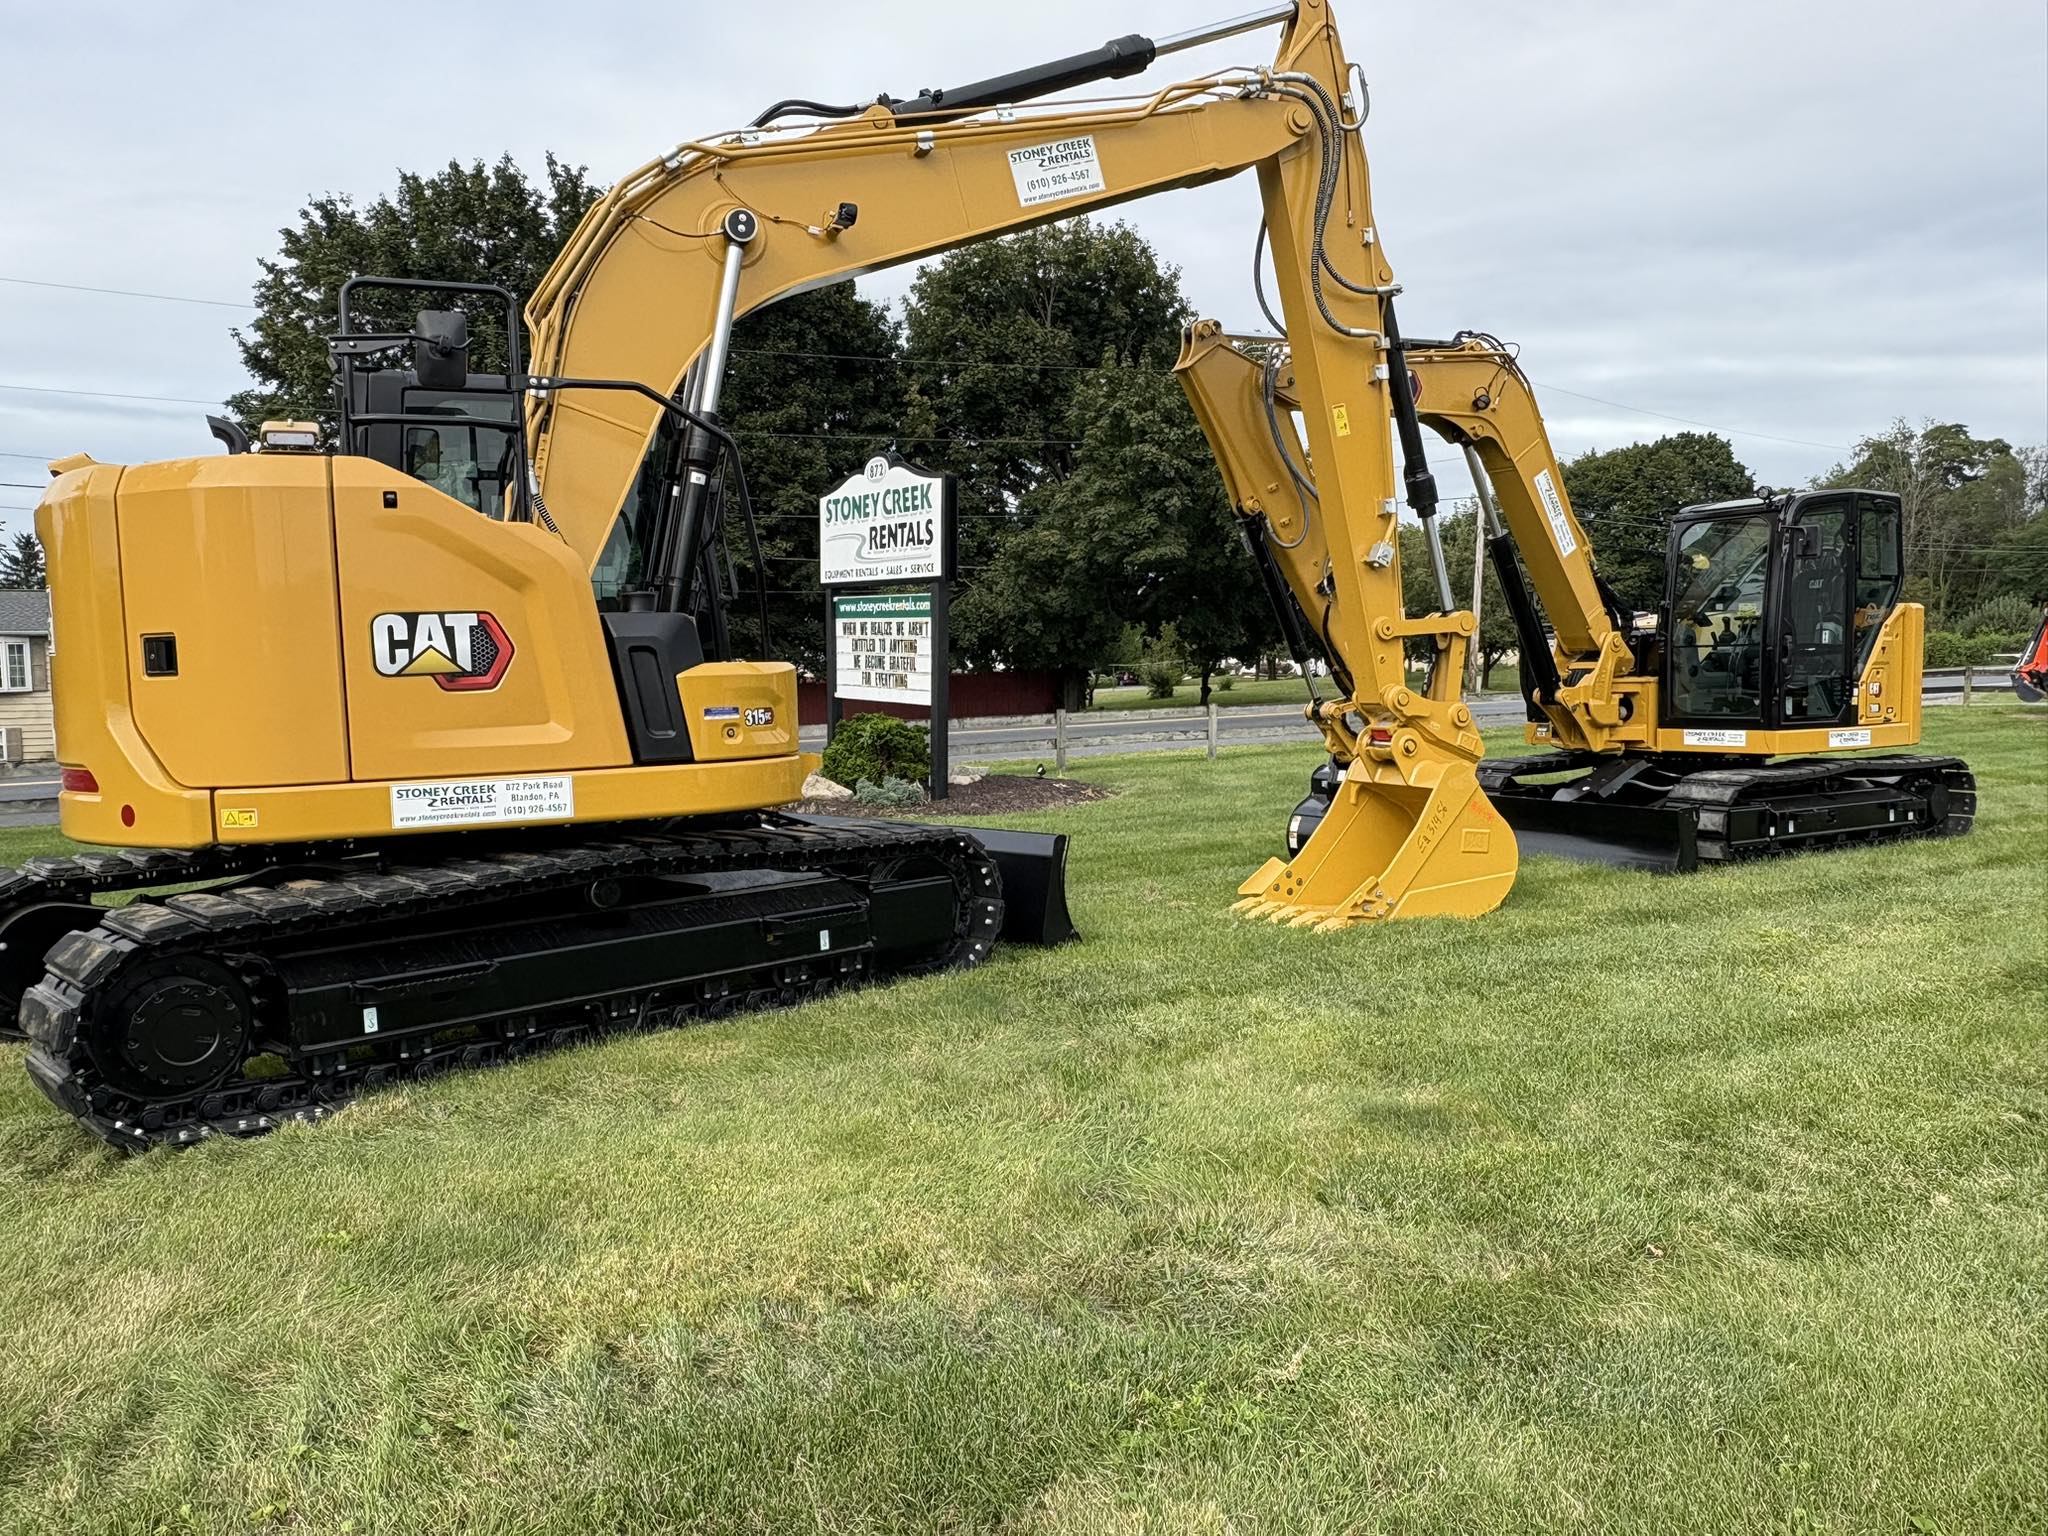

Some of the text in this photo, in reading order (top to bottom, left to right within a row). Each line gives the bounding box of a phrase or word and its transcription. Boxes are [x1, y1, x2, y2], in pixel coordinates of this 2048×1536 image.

[1010, 138, 1091, 163] STONEY CREEK
[1048, 149, 1091, 166] RENTALS
[1027, 169, 1090, 192] (610) 926-4567
[869, 463, 884, 479] 872
[825, 482, 933, 523] STONEY CREEK
[869, 518, 934, 550] RENTALS
[824, 563, 934, 580] EQUIPMENT RENTALS SALES SERVICE
[839, 597, 931, 614] www.stoneycreekrentals.com
[842, 621, 929, 637] WHEN WE REALIZE WE AREN'T
[372, 613, 478, 675] CAT
[851, 638, 918, 653] ENTITLED TO ANYTHING
[854, 655, 917, 671] WE BECOME GRATEFUL
[862, 672, 908, 688] FOR EVERYTHING
[396, 784, 496, 798] STONEY CREEK
[523, 782, 540, 790] Park
[543, 781, 563, 789] Road
[440, 794, 493, 806] RENTALS
[504, 806, 526, 816] (610)
[529, 803, 567, 813] 926-4567
